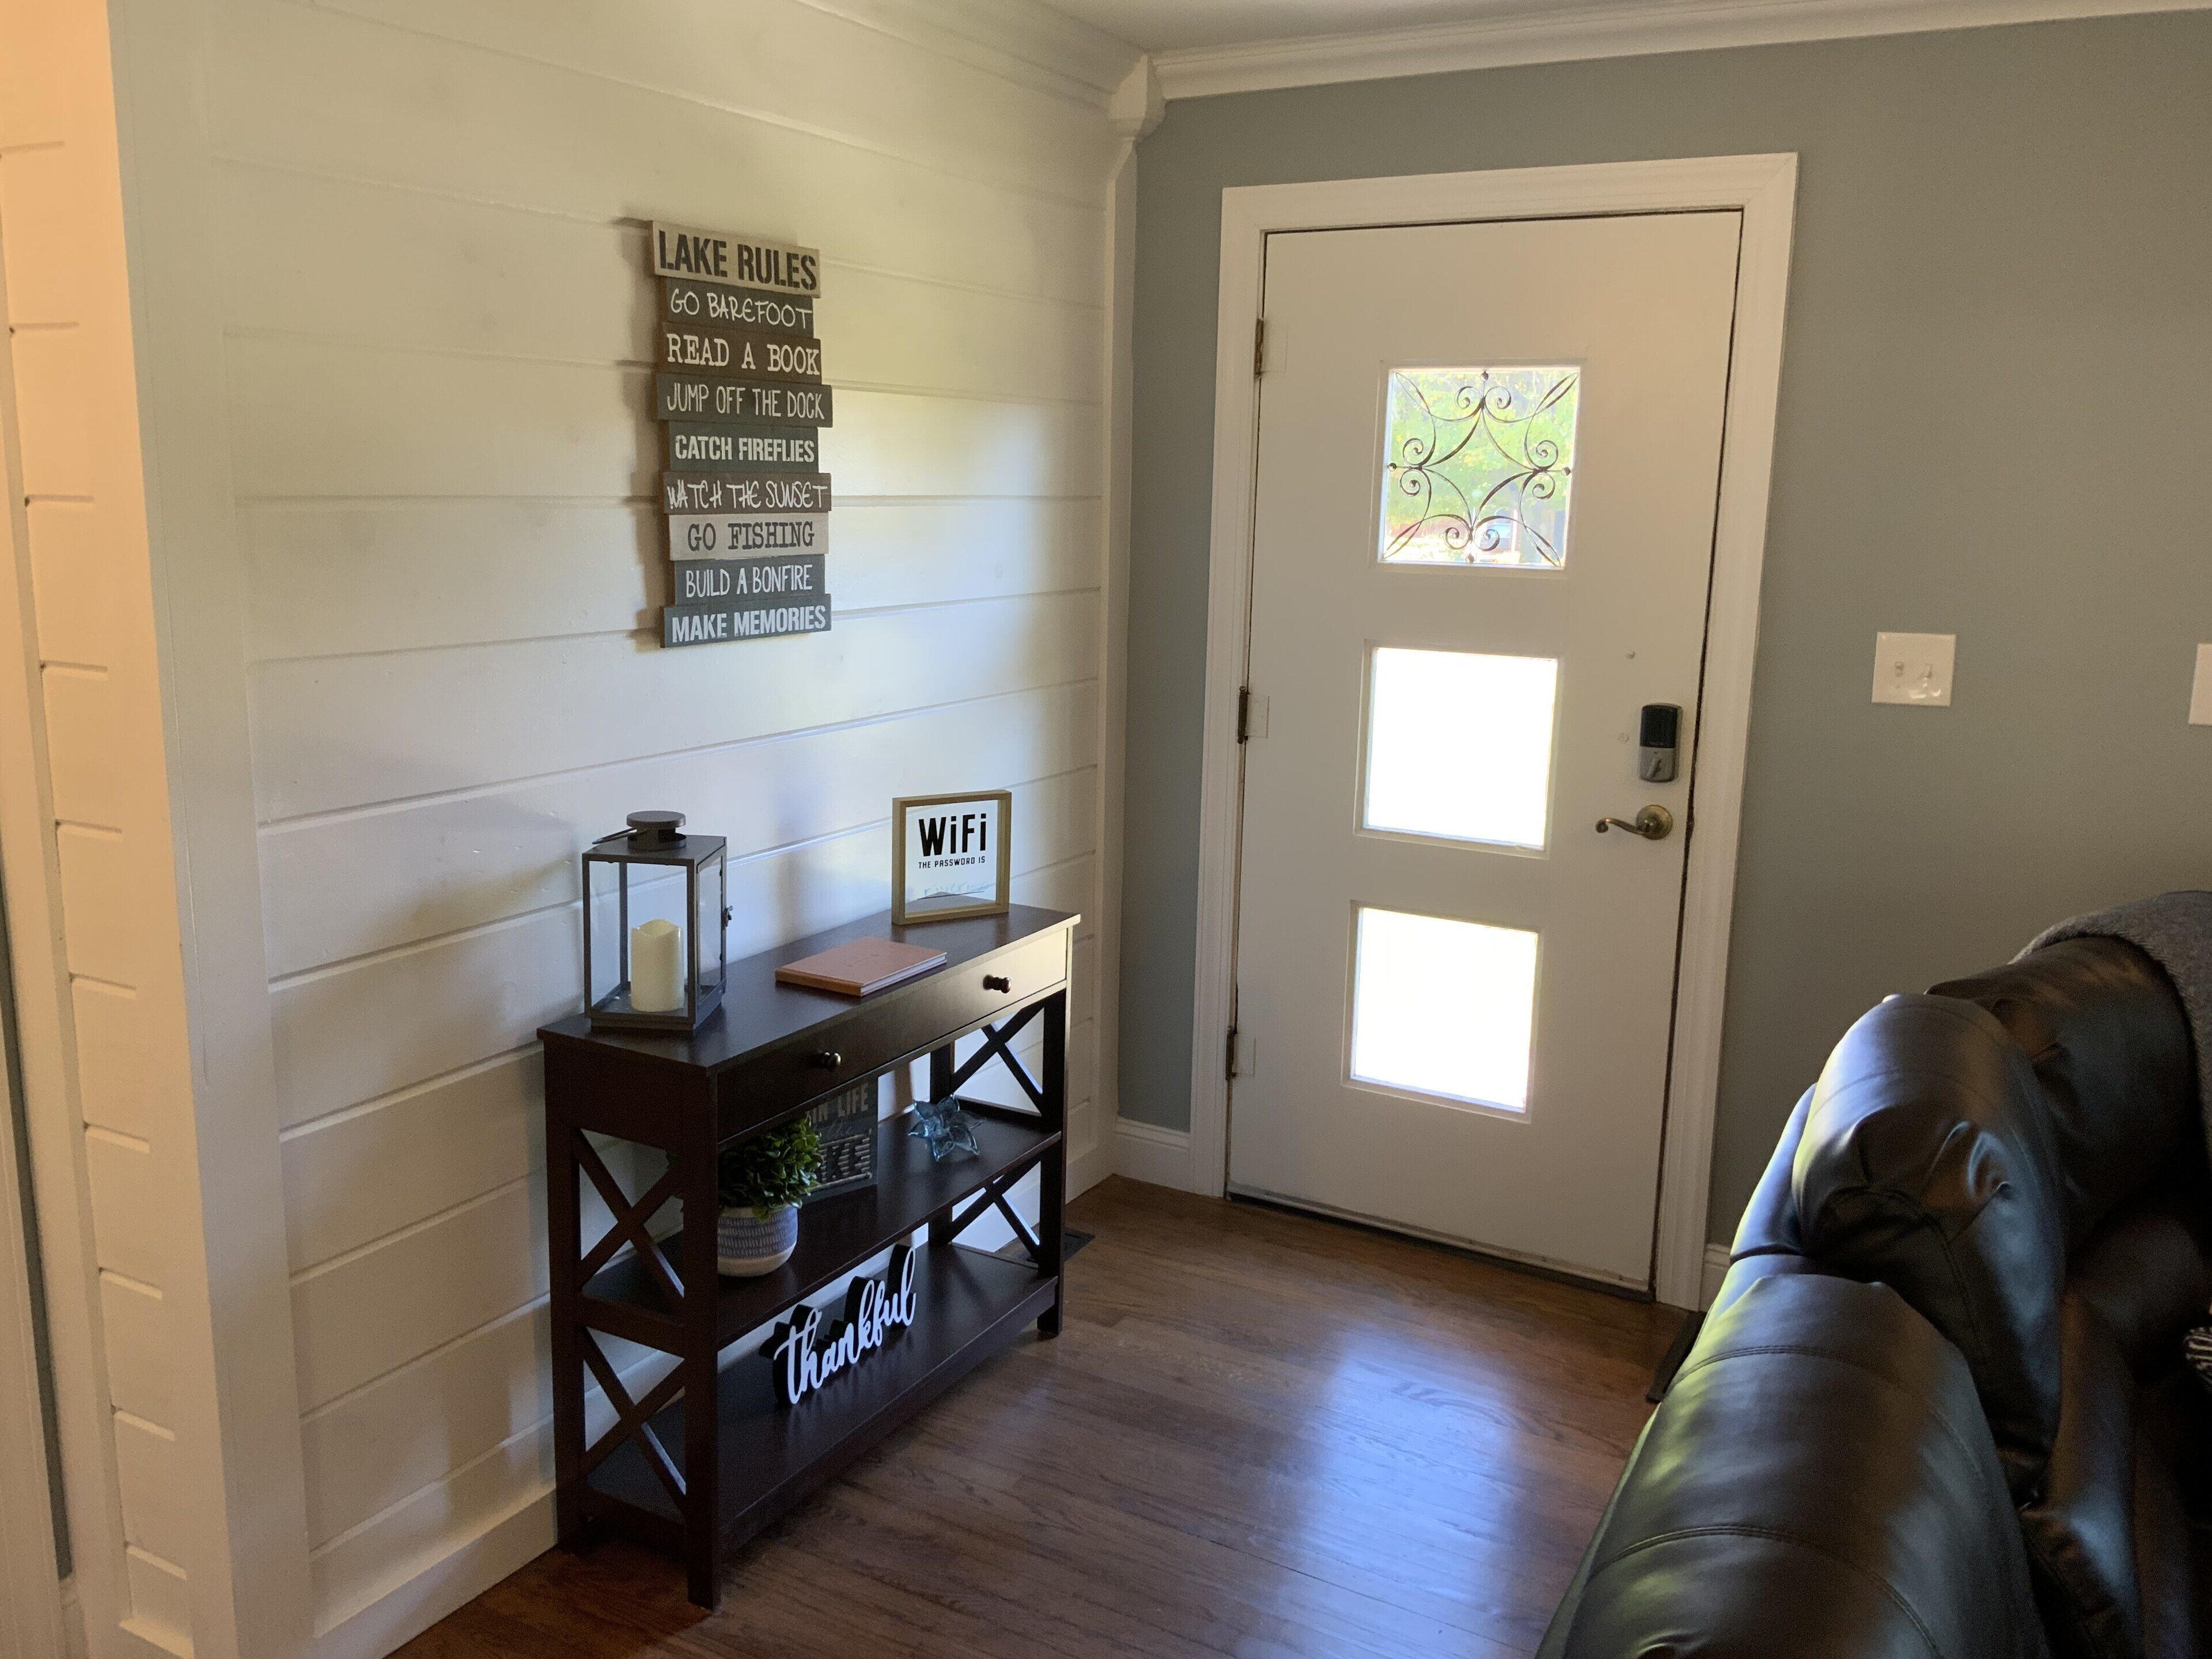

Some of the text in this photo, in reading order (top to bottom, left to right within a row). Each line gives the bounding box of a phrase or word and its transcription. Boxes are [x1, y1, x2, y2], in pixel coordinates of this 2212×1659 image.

[659, 229, 817, 290] LAKE RULES
[671, 288, 812, 329] GO BAREFOOT
[666, 333, 820, 375] READ A BOOK
[667, 382, 824, 419] JUMP OFF THE DOCK
[675, 435, 815, 463] CATCH FIREFLIES
[666, 479, 828, 510] WATCH THE SUNSET
[687, 521, 815, 551] GO FISHING
[685, 564, 813, 598] BUILD A BONFIRE
[672, 605, 827, 643] MAKE MEMORIES
[918, 813, 987, 857] WiFi
[918, 861, 931, 869] THE
[934, 857, 975, 868] PASSWORD
[838, 1083, 868, 1117] LIFE
